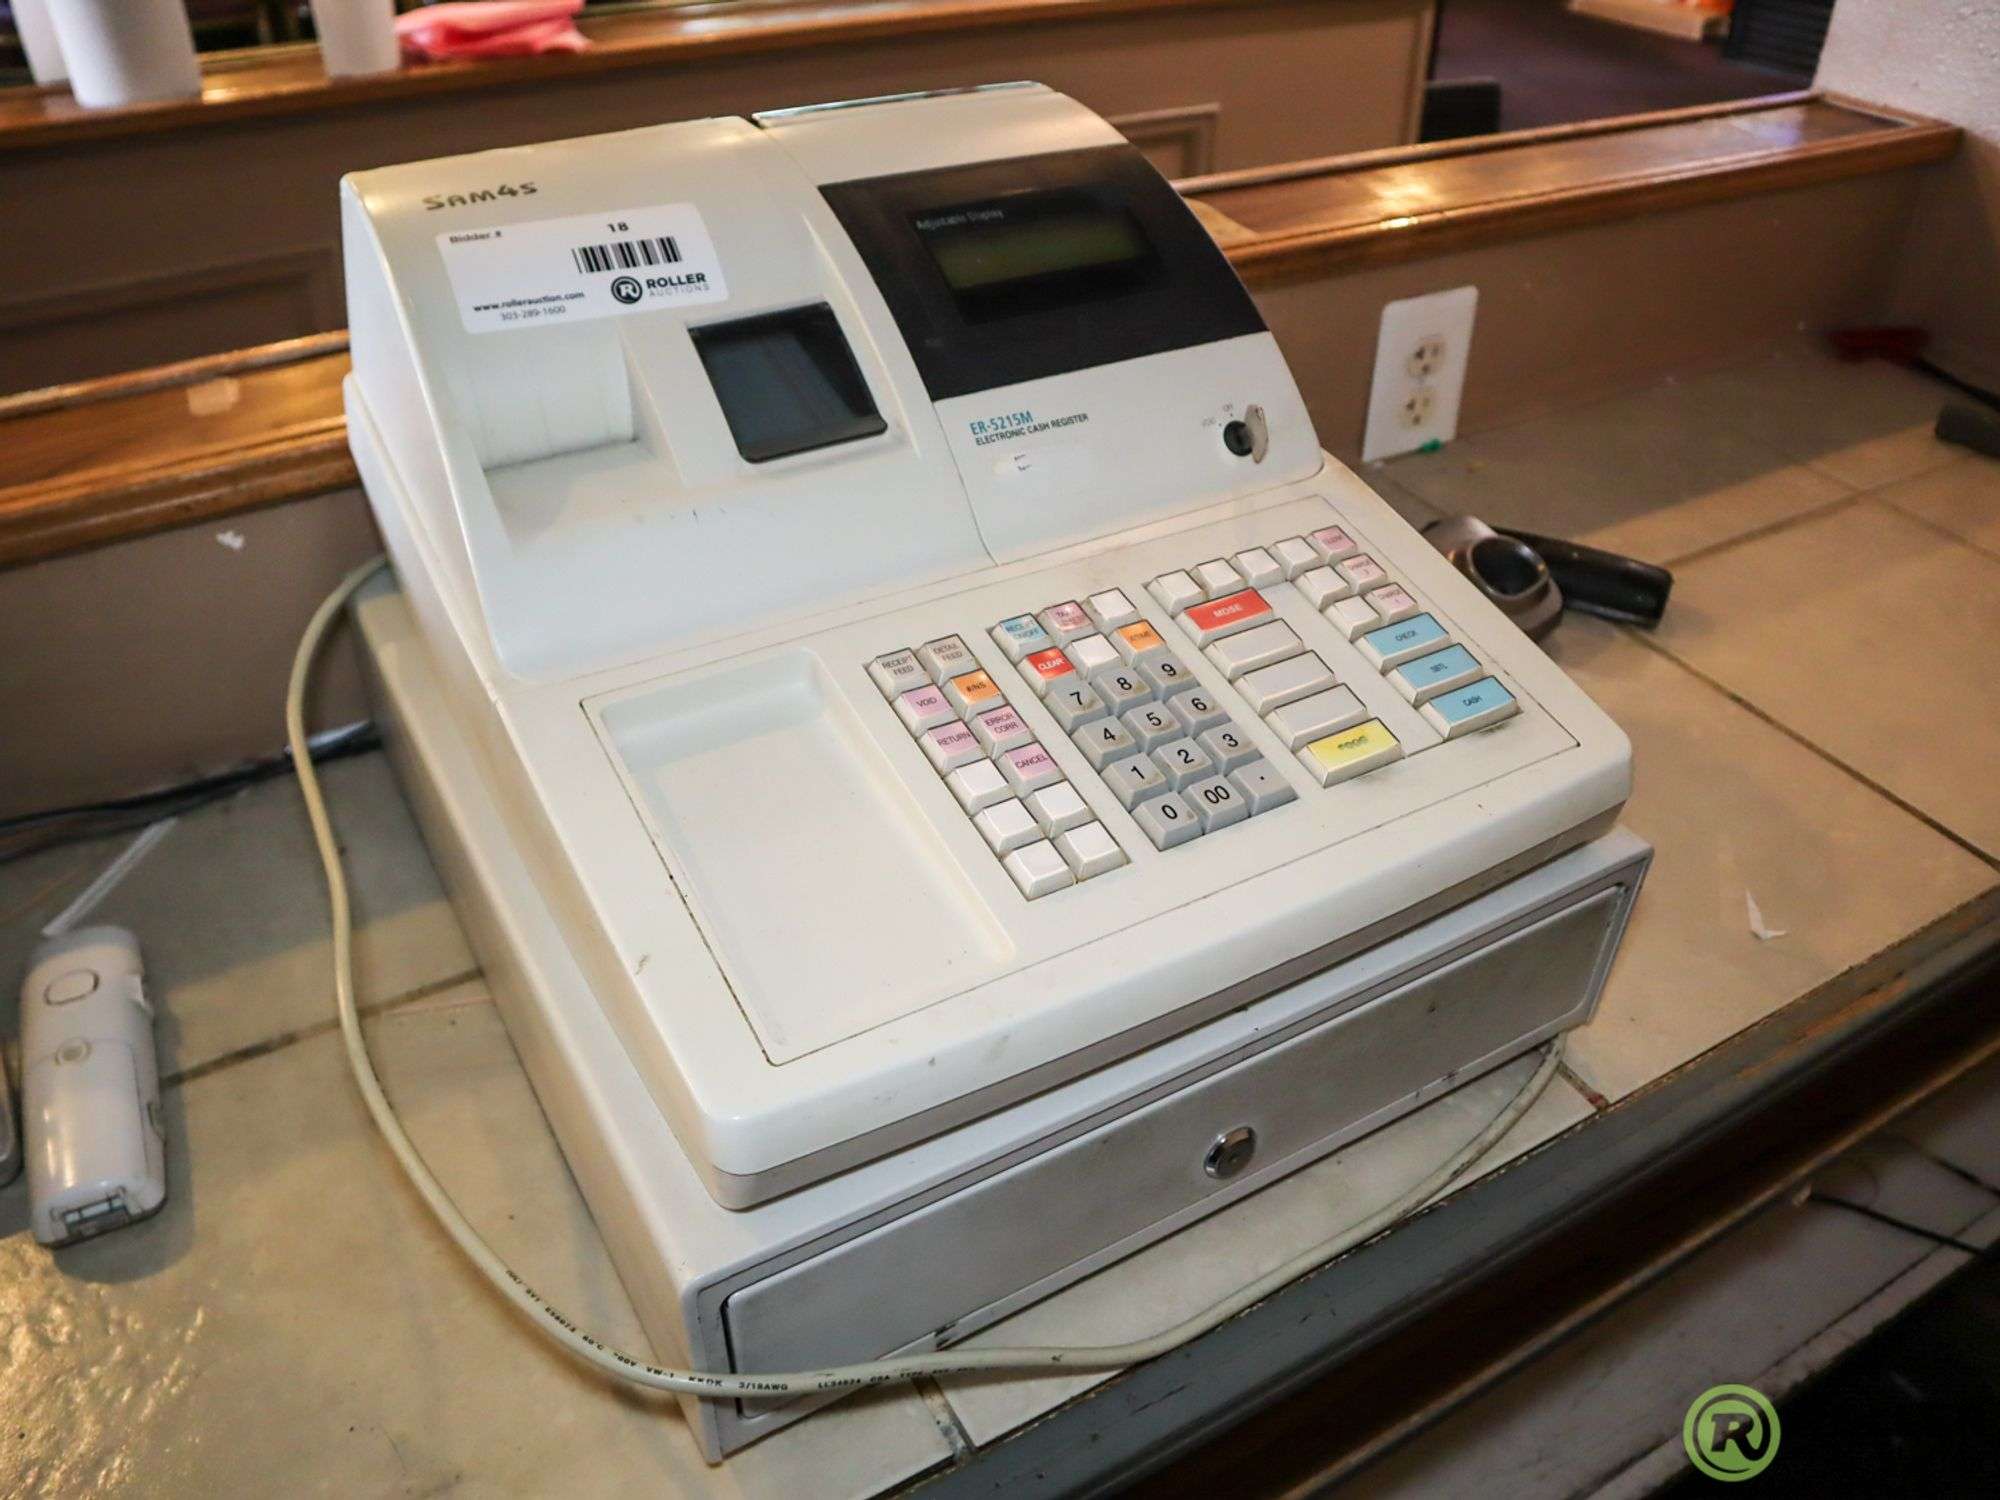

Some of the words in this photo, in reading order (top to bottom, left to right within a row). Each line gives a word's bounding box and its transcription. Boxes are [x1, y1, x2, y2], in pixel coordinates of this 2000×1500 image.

[607, 221, 629, 232] 18
[449, 231, 490, 244] Bidder
[646, 272, 707, 290] ROLLER
[650, 283, 711, 297] AUCTIONS
[473, 291, 585, 313] www.rollerauction.com
[500, 304, 567, 321] 303-289-1600
[969, 409, 1034, 436] ER-5215M
[975, 427, 1027, 446] ELECTRONIC
[1026, 419, 1052, 434] CASH
[1050, 412, 1090, 429] REGISTER
[1036, 658, 1066, 673] CLEAR
[1161, 663, 1177, 678] 9
[1116, 677, 1133, 692] 8
[915, 697, 937, 708] VOID
[1069, 691, 1085, 707] 7
[1191, 698, 1208, 713] 6
[984, 712, 1016, 727] ERROR
[993, 721, 1020, 734] CORR
[1146, 712, 1163, 728] 5
[936, 731, 973, 747] RETURN
[1103, 727, 1117, 743] 4
[1222, 733, 1240, 749] 3
[1014, 753, 1049, 770] CANCEL
[1177, 749, 1195, 766] 2
[1130, 765, 1146, 782] 1
[1204, 785, 1231, 806] 00
[1161, 804, 1179, 822] 0
